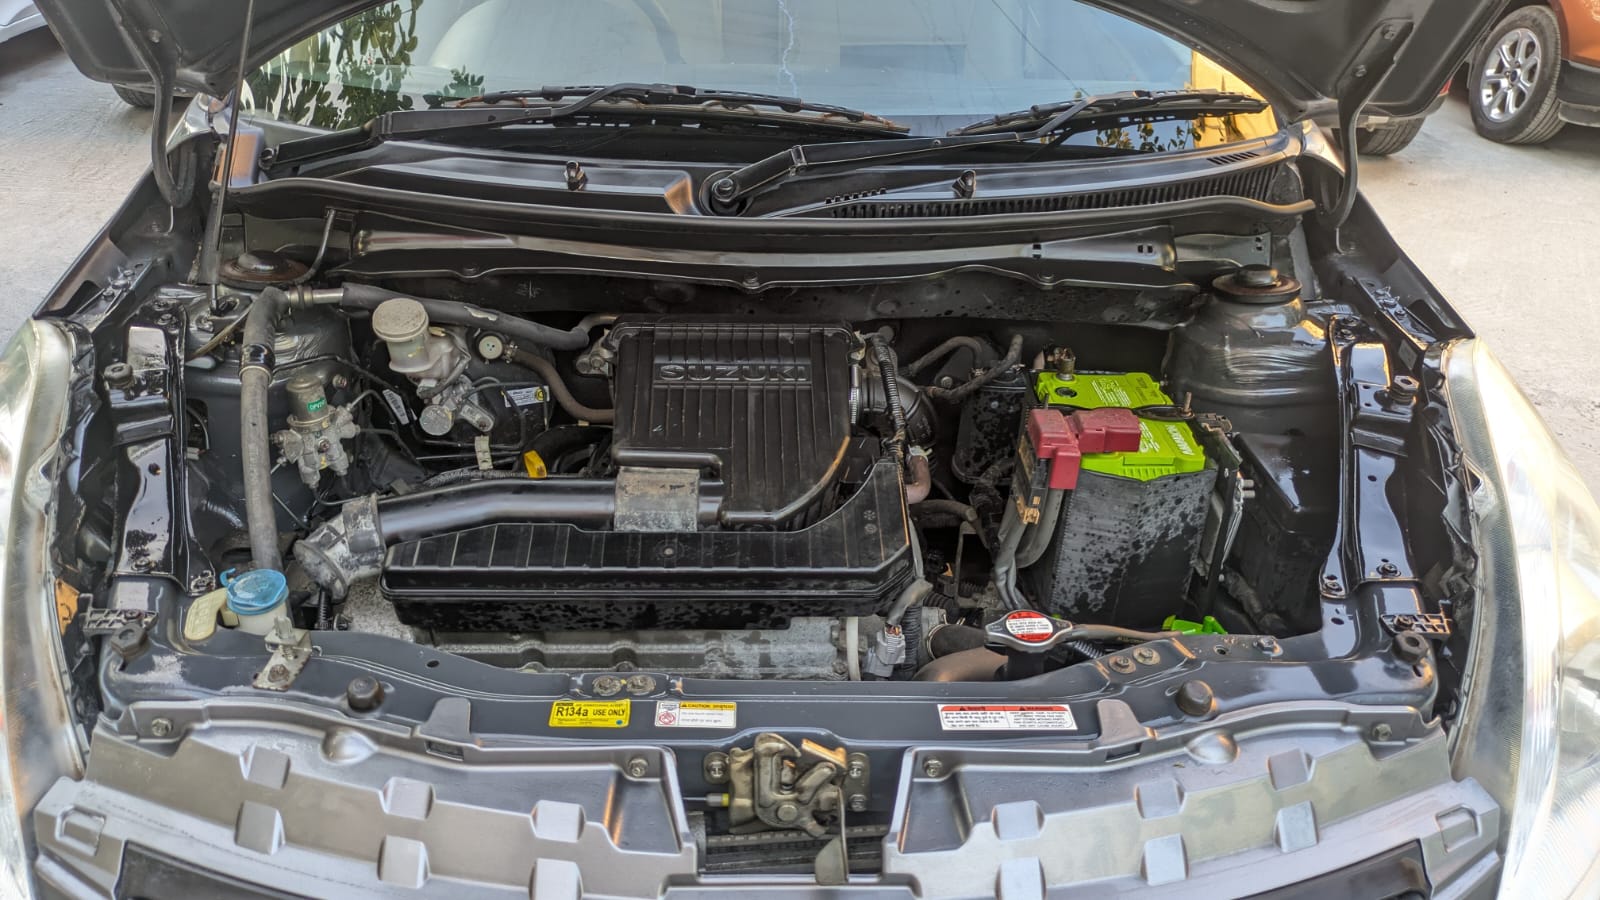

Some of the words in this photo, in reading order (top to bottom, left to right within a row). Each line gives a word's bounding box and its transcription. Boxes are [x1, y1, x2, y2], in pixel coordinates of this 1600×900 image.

[660, 364, 807, 382] SUZUKI
[556, 706, 589, 717] R134a
[593, 708, 608, 716] USE
[608, 708, 626, 717] ONLY
